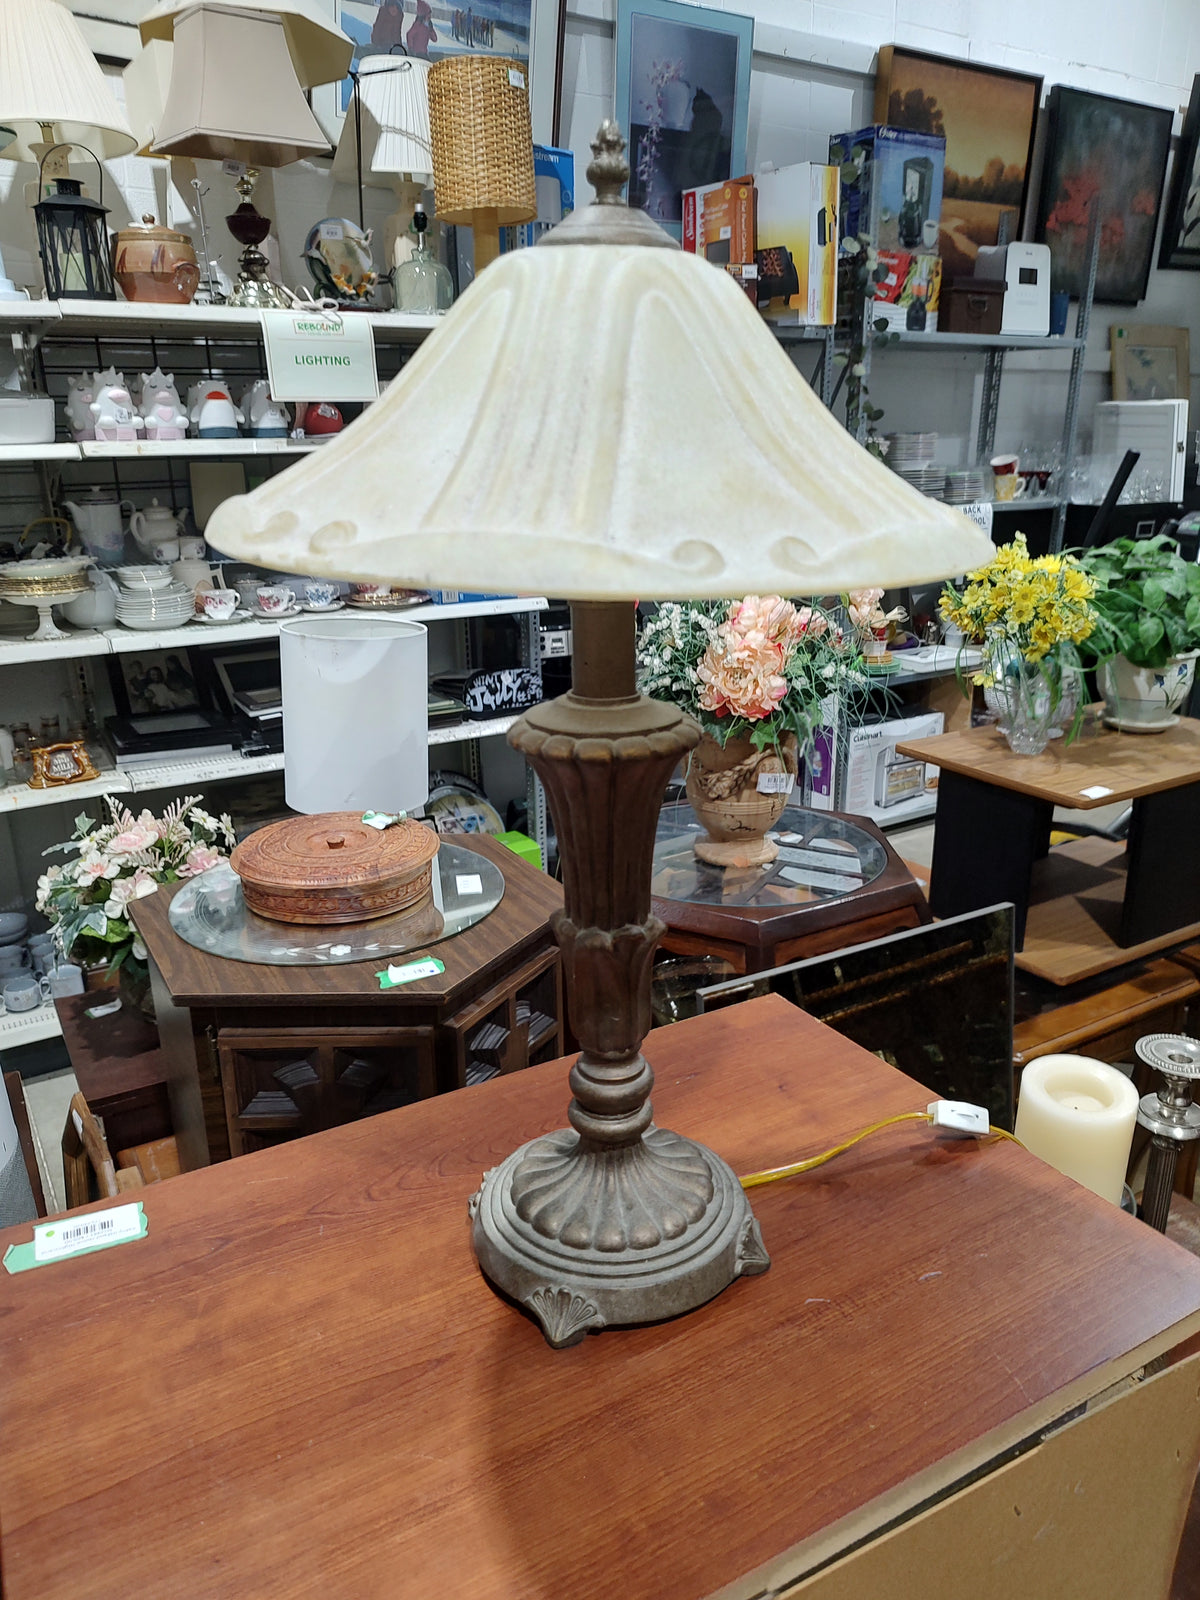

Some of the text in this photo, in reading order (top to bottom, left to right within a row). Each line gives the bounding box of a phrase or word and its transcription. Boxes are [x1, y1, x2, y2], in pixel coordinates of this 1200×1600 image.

[296, 322, 341, 331] REBOUND
[294, 355, 351, 366] LIGHTING
[853, 731, 883, 743] Cuisinart
